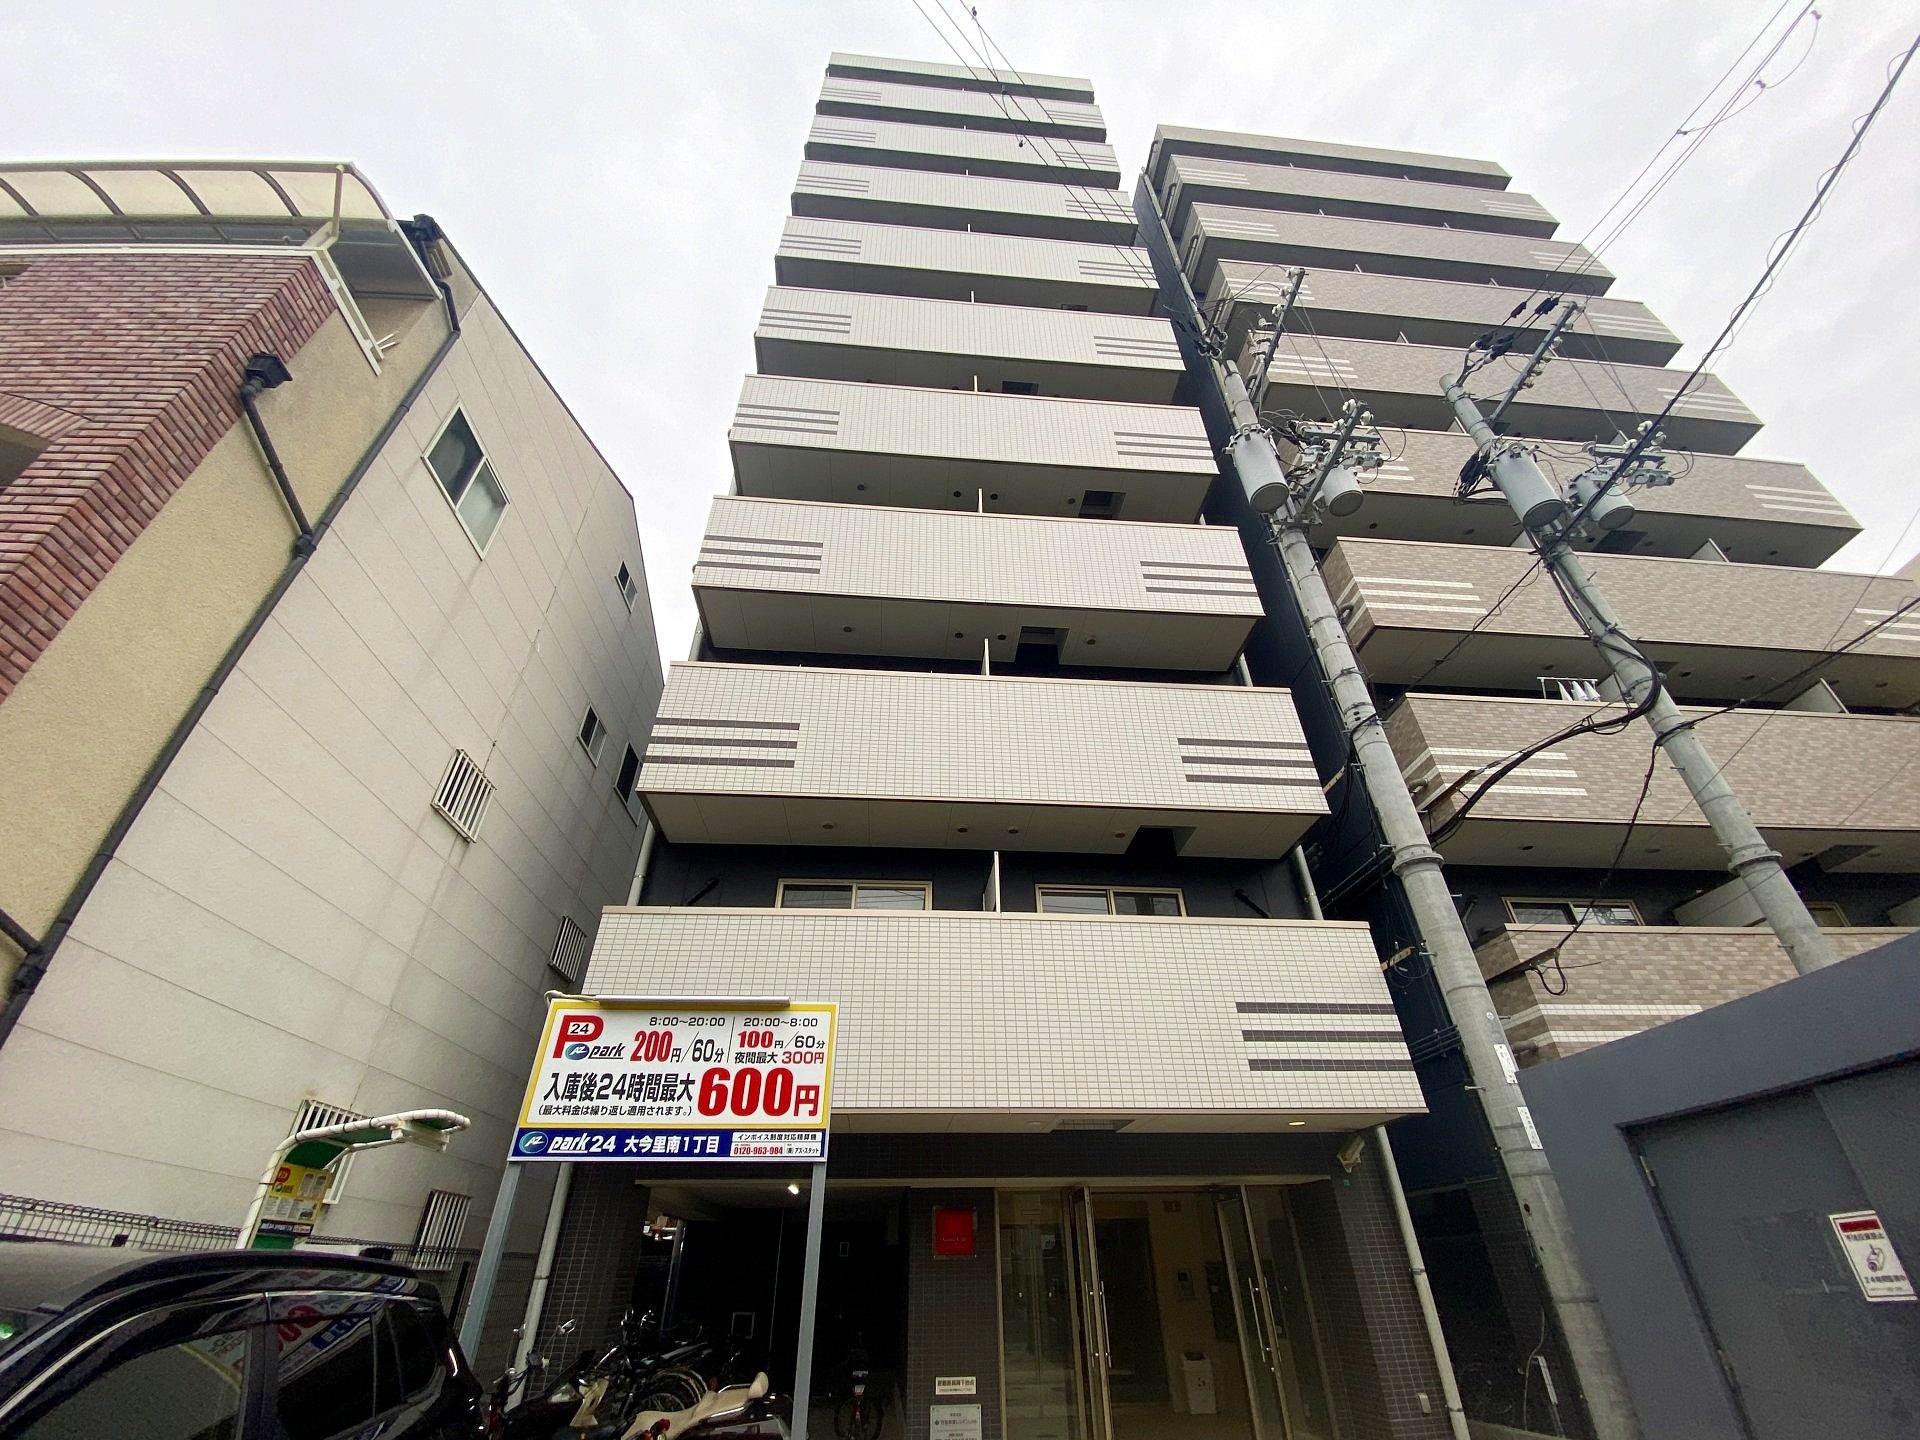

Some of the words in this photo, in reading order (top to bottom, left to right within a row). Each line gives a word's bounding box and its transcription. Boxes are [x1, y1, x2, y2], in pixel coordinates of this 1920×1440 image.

[552, 1015, 604, 1058] P
[570, 1023, 589, 1034] 24
[588, 1042, 626, 1060] park
[734, 1052, 778, 1064] 夜間最大
[781, 1051, 824, 1064] 300円
[544, 1072, 695, 1102] 入庫後24時間最大
[697, 1067, 820, 1117] 600円
[525, 1136, 544, 1147] AZ
[623, 1136, 720, 1153] 大今里南1丁目
[733, 1147, 783, 1155] 0120-963-984
